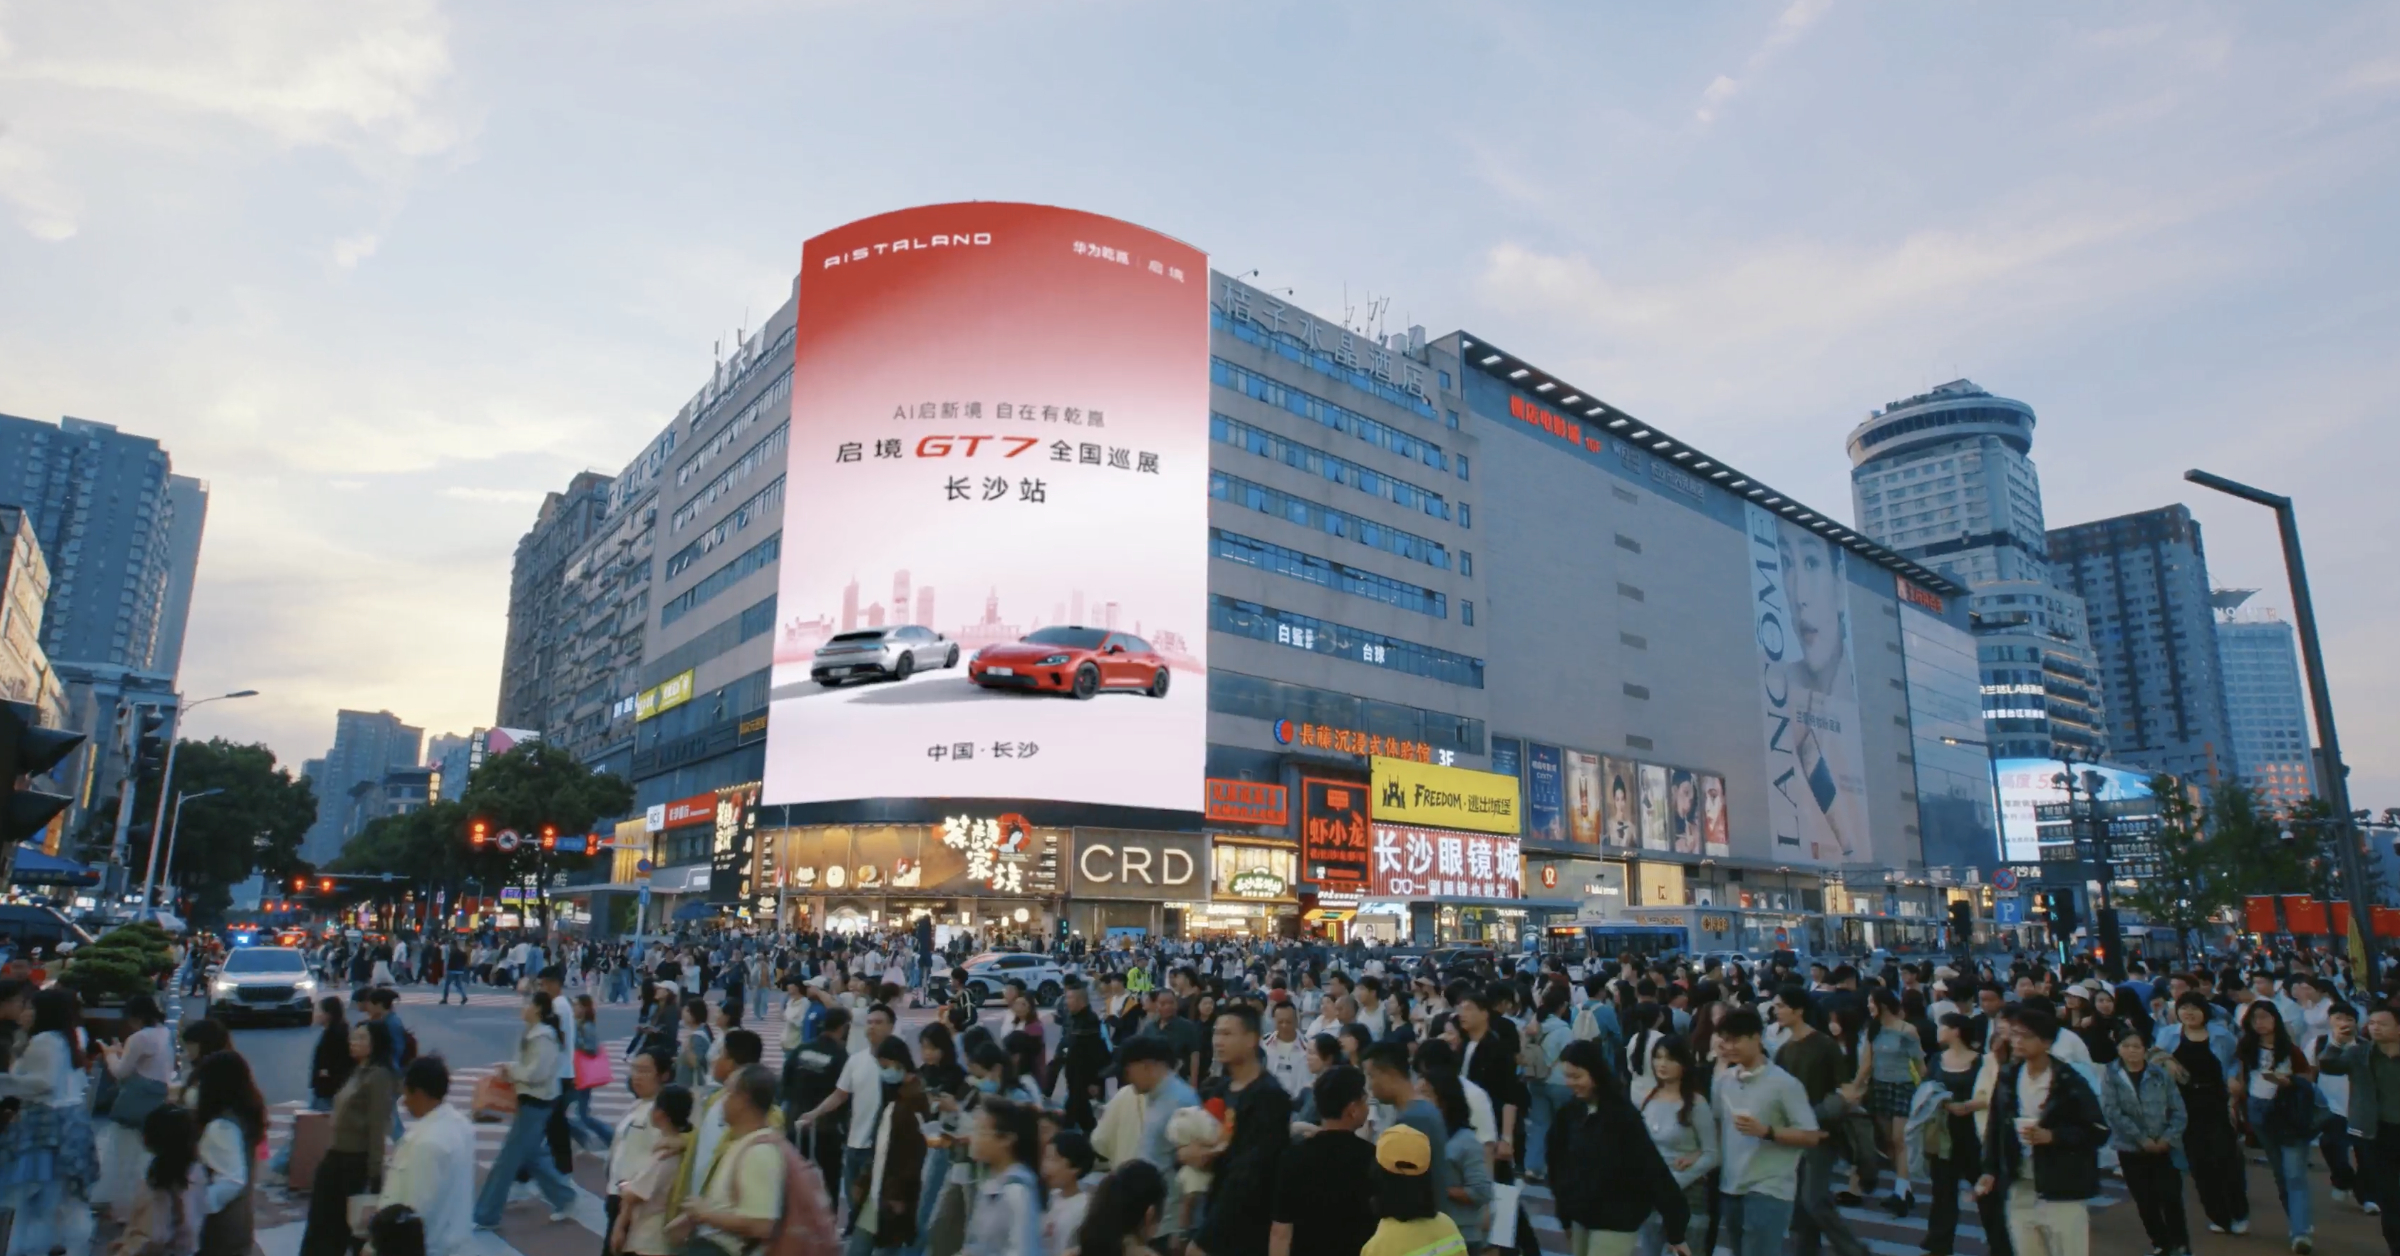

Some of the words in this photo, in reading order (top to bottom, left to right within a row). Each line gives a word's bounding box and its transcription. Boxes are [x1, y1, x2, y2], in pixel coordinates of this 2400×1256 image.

[823, 231, 992, 270] AISTALAND
[1221, 279, 1425, 399] 桔子水晶酒店
[835, 438, 904, 464] 启境
[915, 435, 1041, 459] GT7
[1049, 440, 1162, 475] 全国巡展
[944, 475, 1048, 504] 长沙站
[1362, 642, 1386, 664] 台球
[927, 741, 1040, 762] 中国·长沙
[1438, 748, 1455, 766] 3F
[1413, 782, 1462, 807] FREEDOM
[1467, 794, 1512, 819] 逃出城堡
[1309, 810, 1366, 847] 虾小龙
[1080, 843, 1194, 885] CRD
[1373, 829, 1520, 881] 长沙眼镜城
[2003, 903, 2016, 922] P
